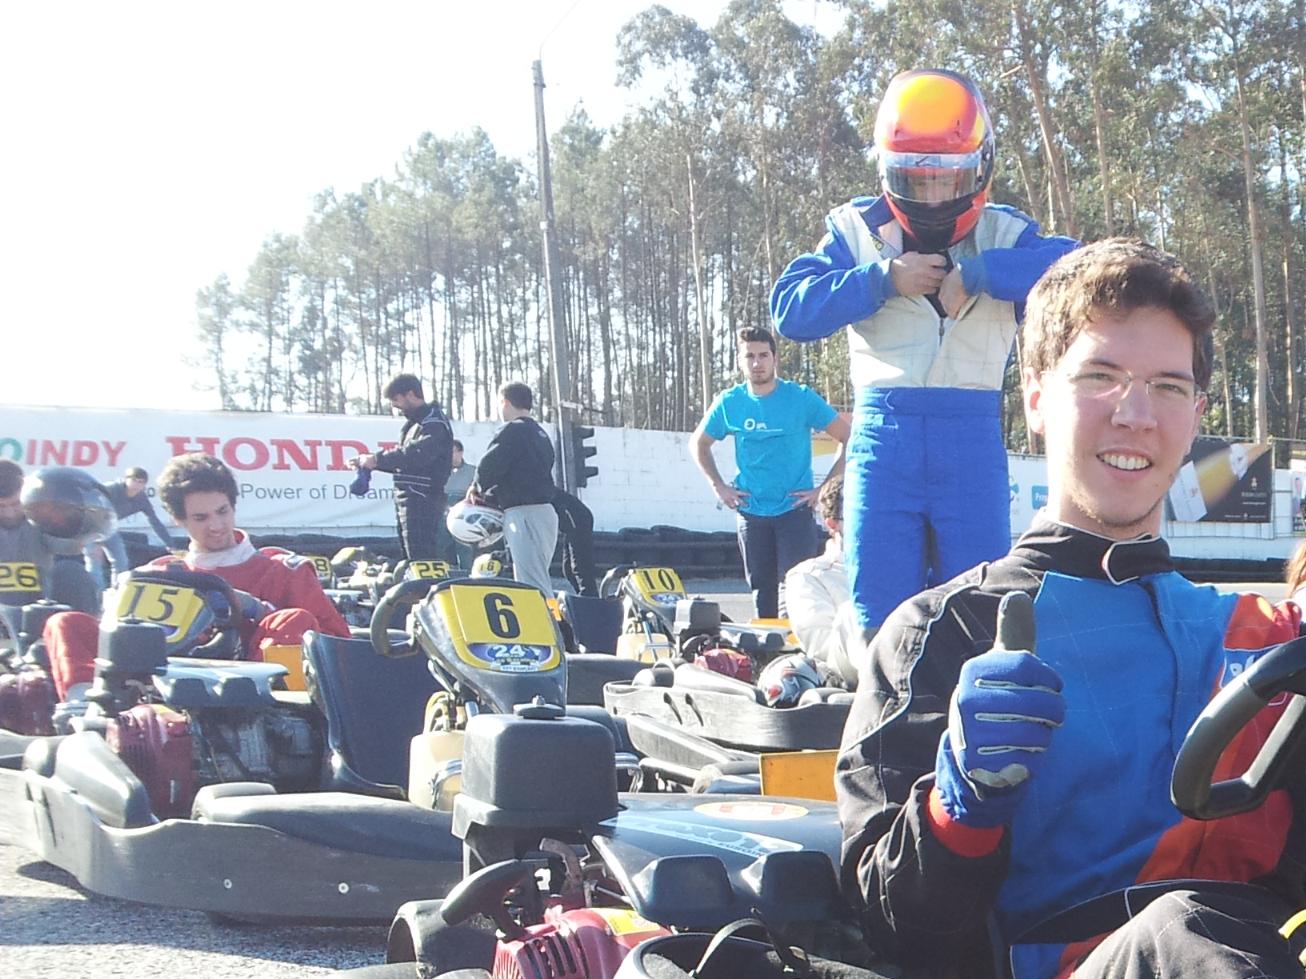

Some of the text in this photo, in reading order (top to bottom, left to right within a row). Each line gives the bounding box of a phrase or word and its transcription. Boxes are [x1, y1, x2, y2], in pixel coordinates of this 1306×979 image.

[165, 436, 400, 471] HOND
[240, 483, 301, 499] Power
[309, 484, 327, 499] of
[0, 566, 37, 588] 26
[415, 562, 445, 578] 25
[642, 569, 675, 591] 10
[120, 585, 179, 621] 15
[483, 592, 521, 639] 6
[494, 645, 525, 658] 24
